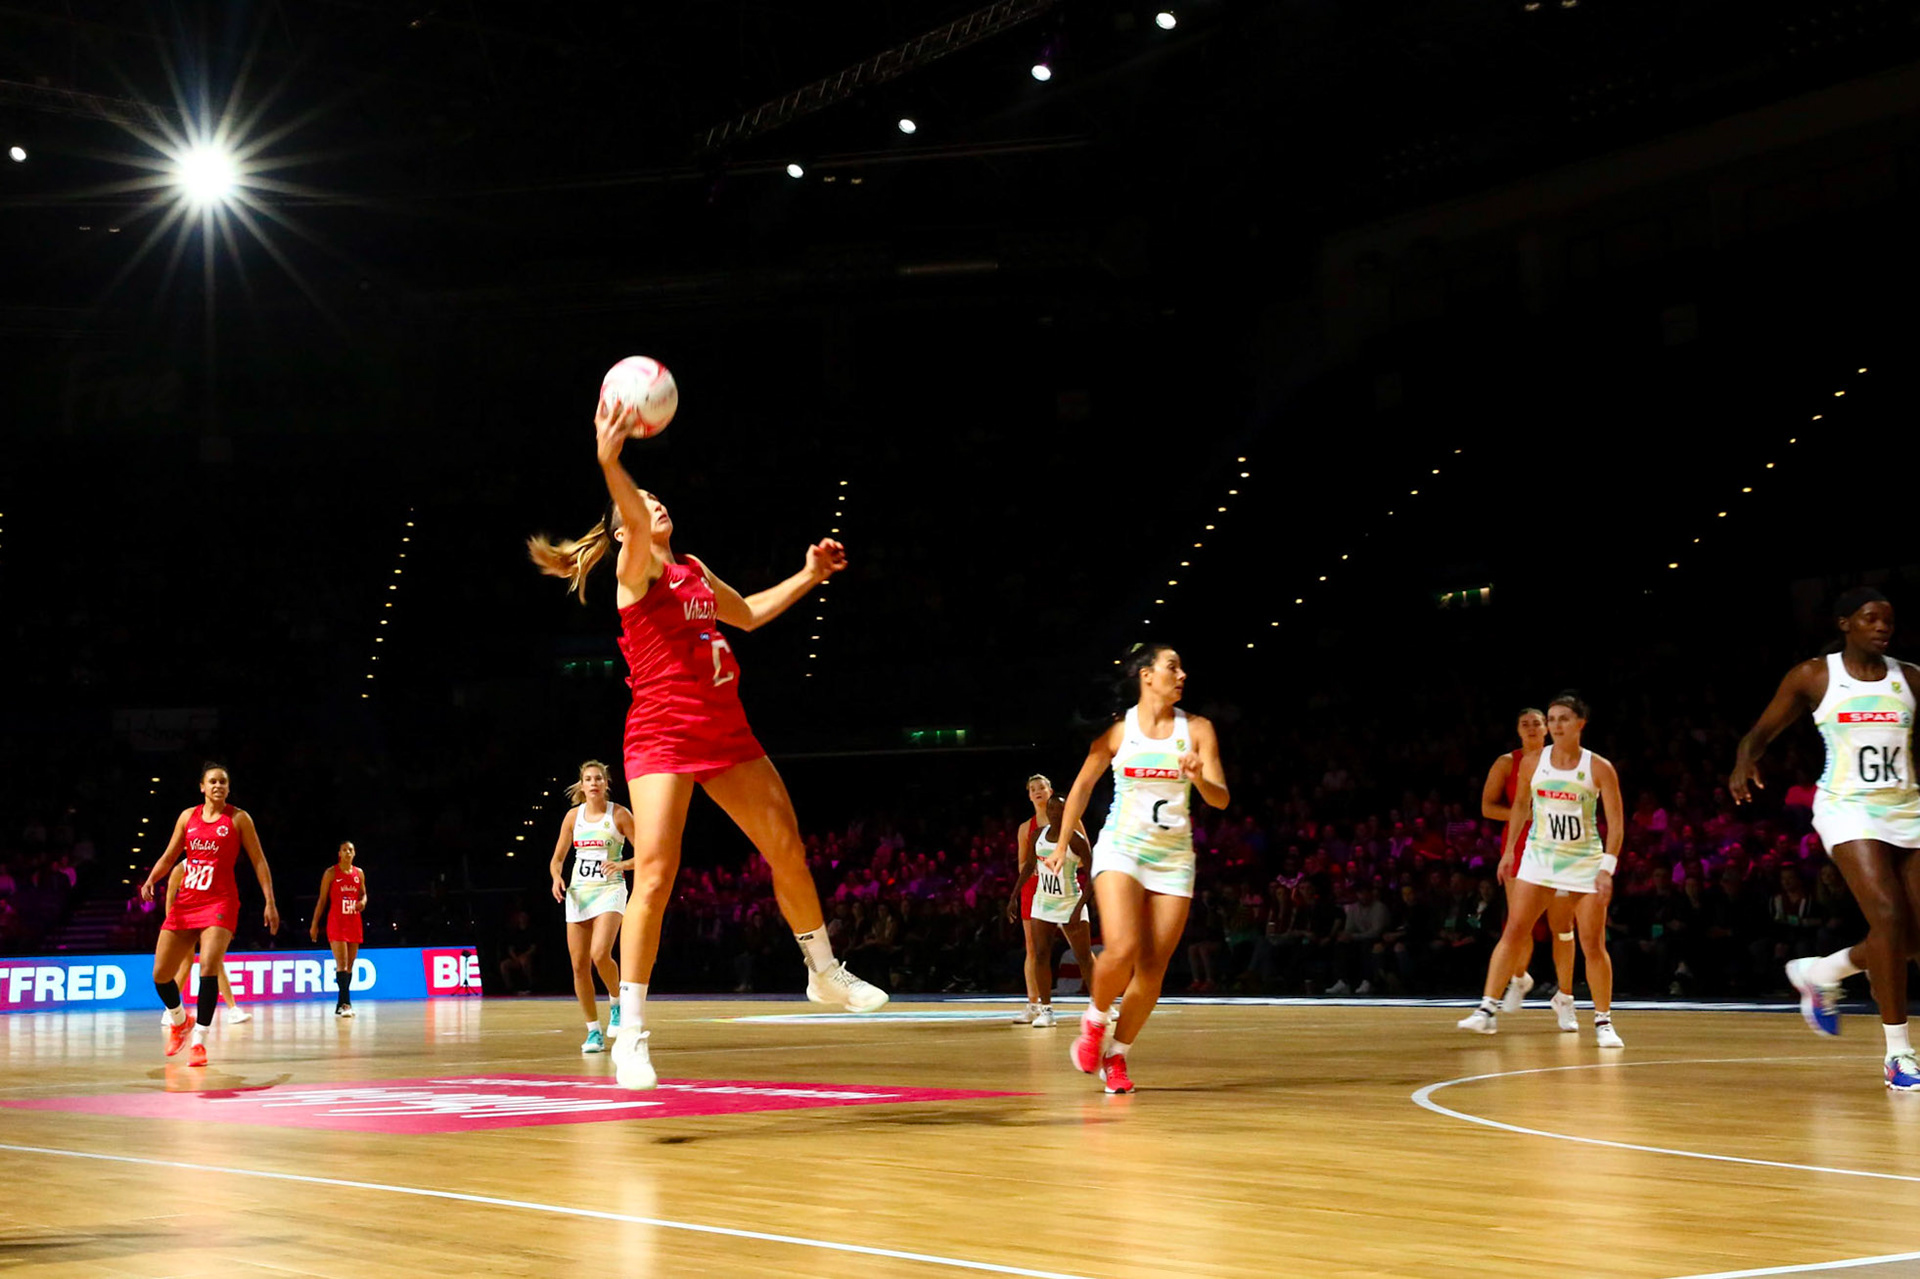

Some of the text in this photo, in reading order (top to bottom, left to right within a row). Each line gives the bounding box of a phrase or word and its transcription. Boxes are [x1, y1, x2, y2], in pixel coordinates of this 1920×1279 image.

[1849, 712, 1898, 722] SPAR
[1134, 768, 1179, 779] SPAR
[1858, 745, 1903, 783] GK
[1544, 789, 1577, 801] SPAR
[1152, 799, 1170, 830] C
[1547, 813, 1581, 841] WD
[579, 859, 604, 878] GA
[1040, 872, 1063, 895] WA
